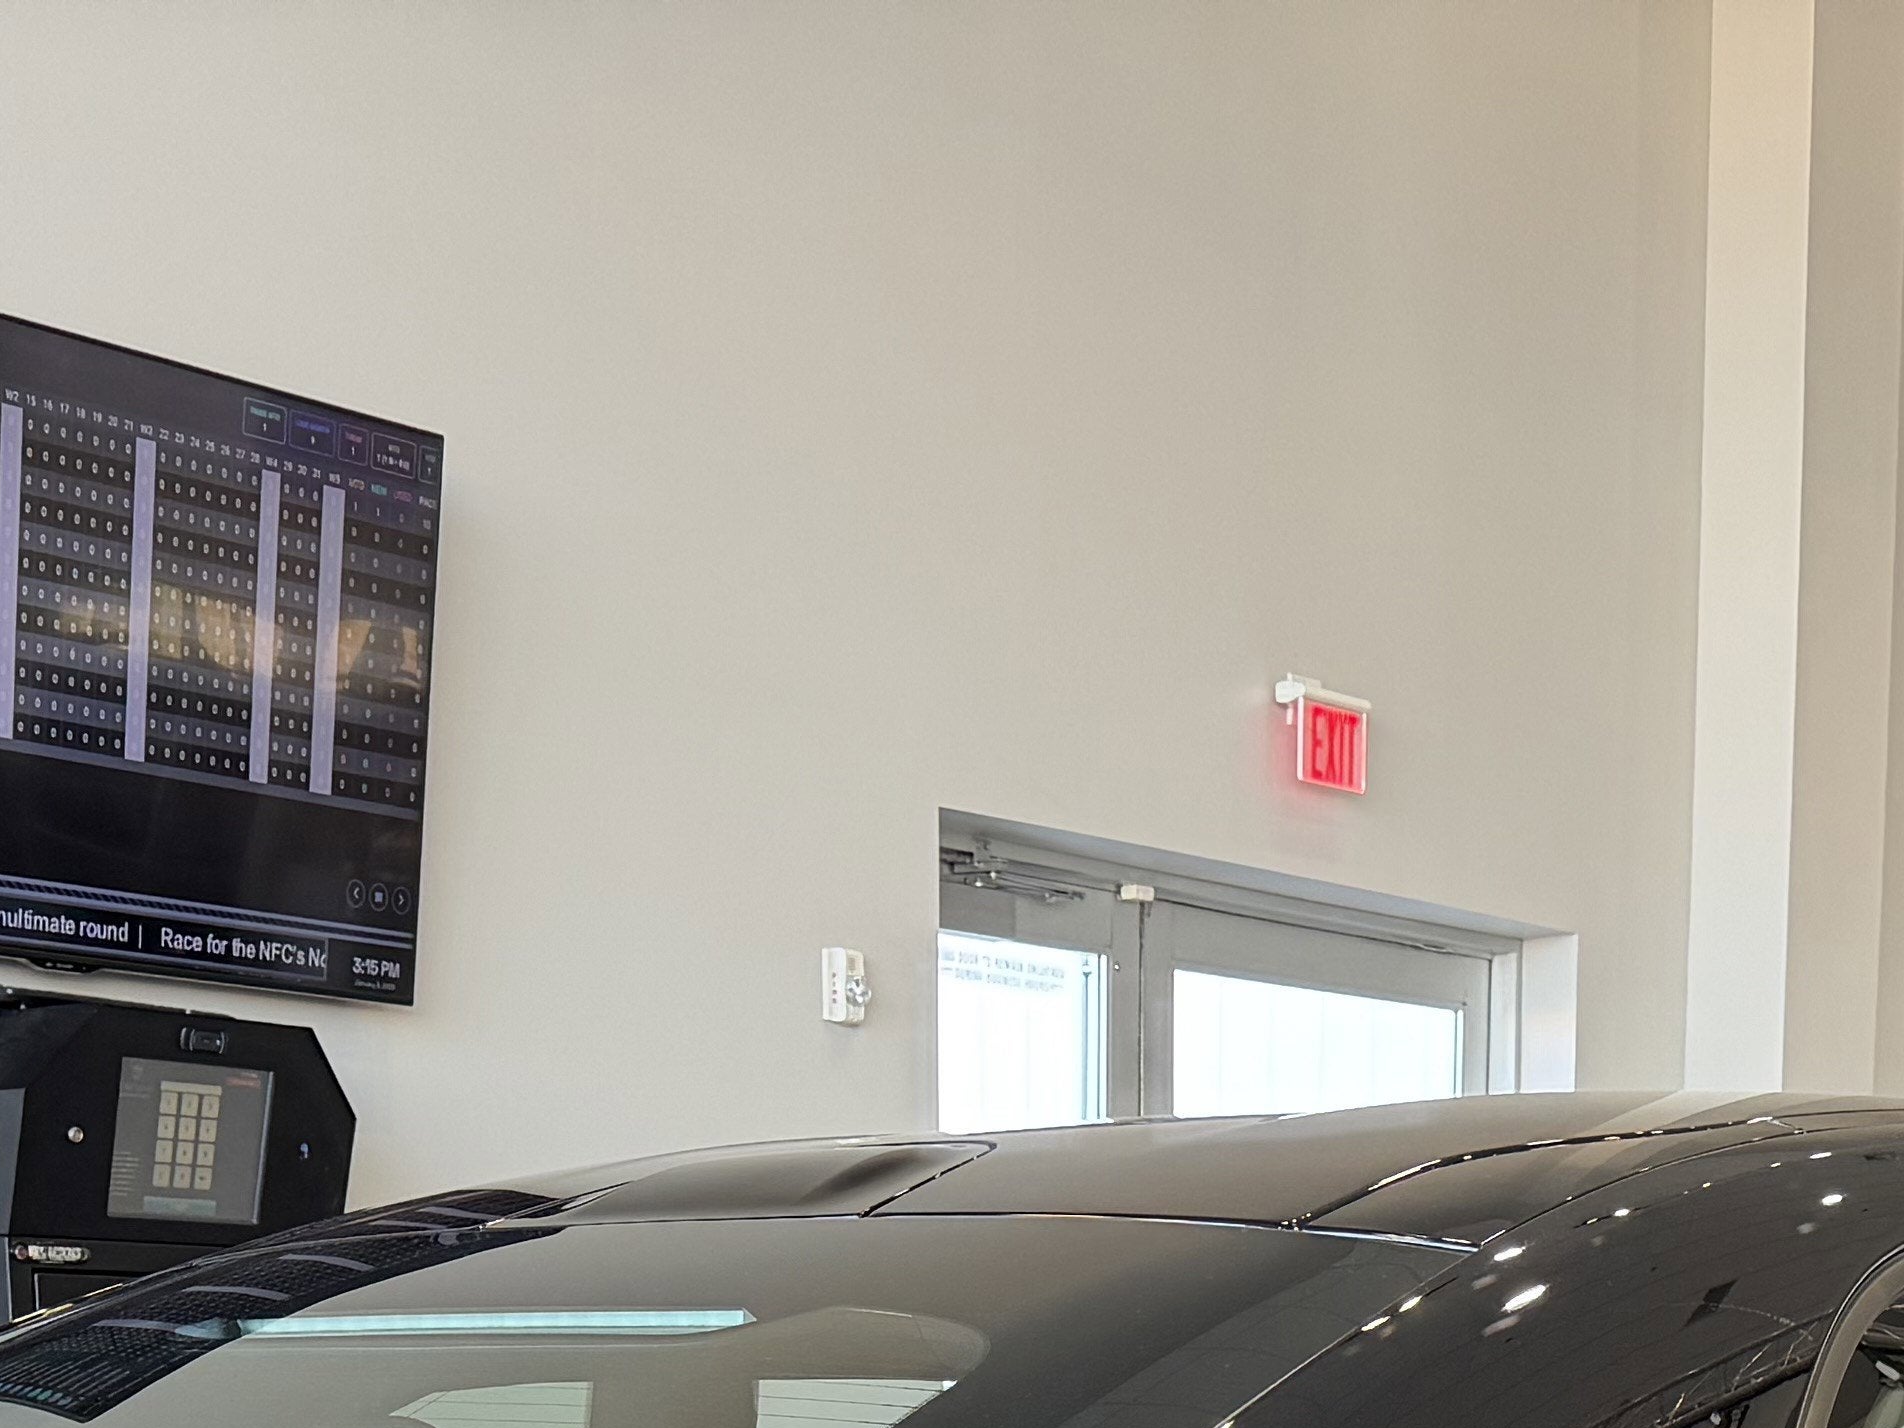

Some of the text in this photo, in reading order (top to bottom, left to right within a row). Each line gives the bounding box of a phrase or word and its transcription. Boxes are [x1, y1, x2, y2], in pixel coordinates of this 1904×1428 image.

[1311, 705, 1361, 788] EXIT
[78, 916, 129, 943] round
[159, 926, 203, 953] Race
[205, 931, 228, 956] for
[231, 936, 256, 960] the
[258, 939, 306, 967] NFC's
[351, 955, 401, 980] 3:15 PM
